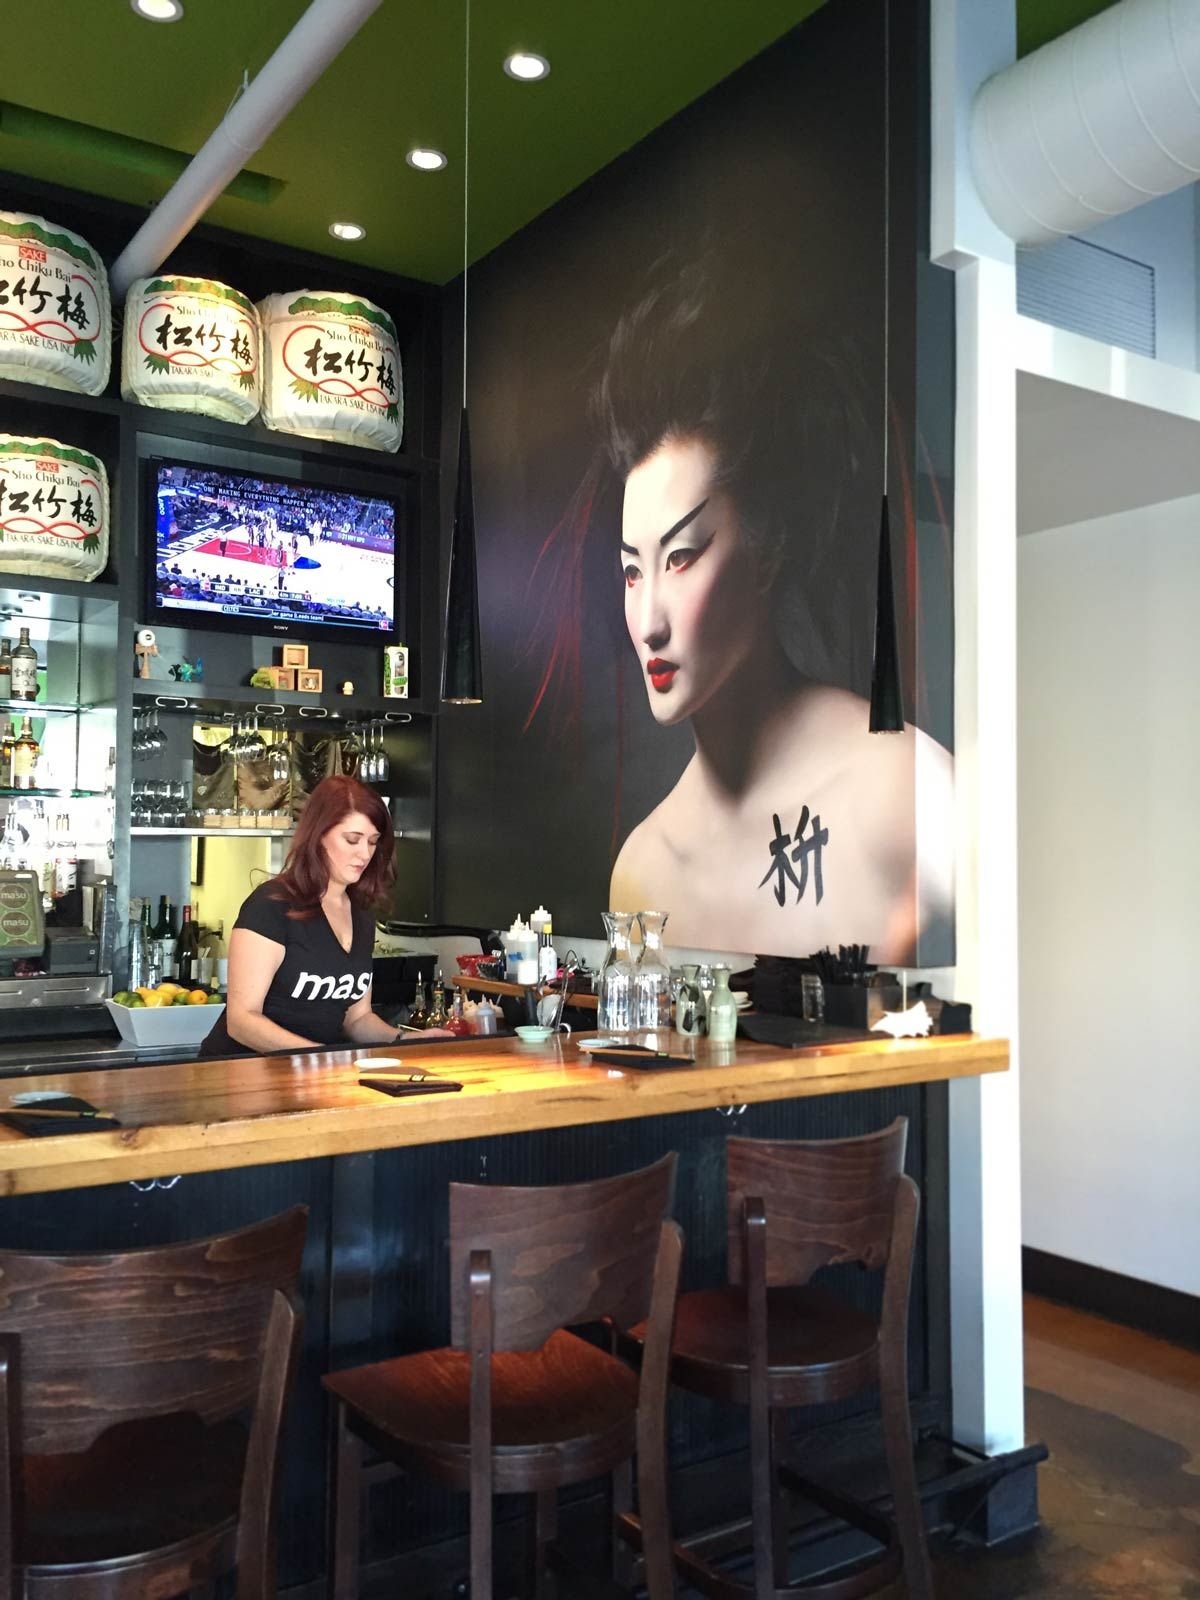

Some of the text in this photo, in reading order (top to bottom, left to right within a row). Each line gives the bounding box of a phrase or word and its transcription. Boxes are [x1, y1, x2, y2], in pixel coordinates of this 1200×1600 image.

[19, 247, 46, 262] SAKE
[19, 259, 52, 278] Chiku
[55, 267, 72, 283] Bai
[19, 333, 40, 347] SAKE
[42, 339, 59, 351] USA
[155, 313, 253, 366] 松竹梅
[326, 330, 346, 342] Sho
[171, 367, 198, 376] TAKARA
[304, 337, 396, 396] 松竹梅
[320, 395, 348, 408] TAKARA
[349, 398, 365, 411] SAKE
[36, 462, 59, 473] SAKE
[12, 470, 32, 480] Sho
[36, 473, 65, 486] Chiku
[243, 491, 280, 504] EVERYTHING
[6, 533, 36, 544] TAKARA
[37, 535, 54, 546] SAKE
[3, 917, 29, 927] masu
[291, 972, 373, 1001] mas
